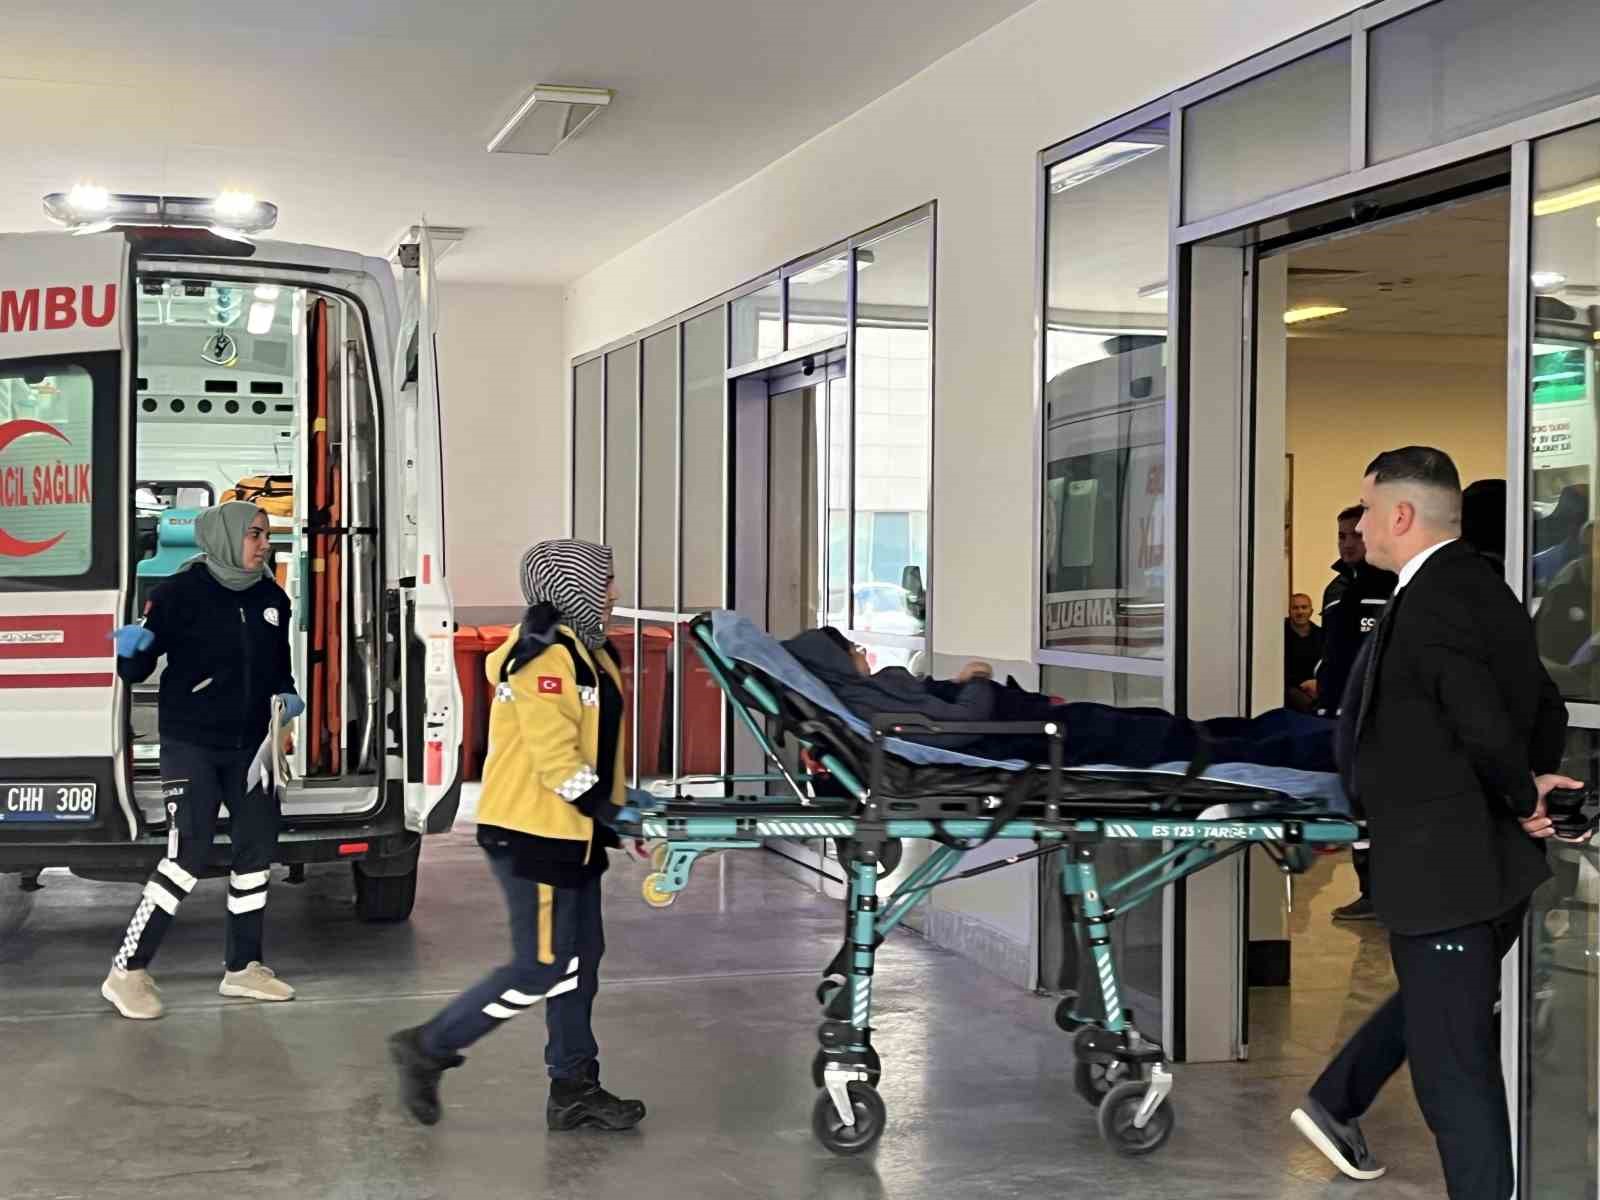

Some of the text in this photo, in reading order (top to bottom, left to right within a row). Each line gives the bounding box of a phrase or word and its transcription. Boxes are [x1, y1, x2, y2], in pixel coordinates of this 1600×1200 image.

[0, 284, 117, 333] MBU
[33, 460, 91, 505] SAĞLIK
[8, 787, 92, 812] CHH 308
[1152, 825, 1169, 837] ES
